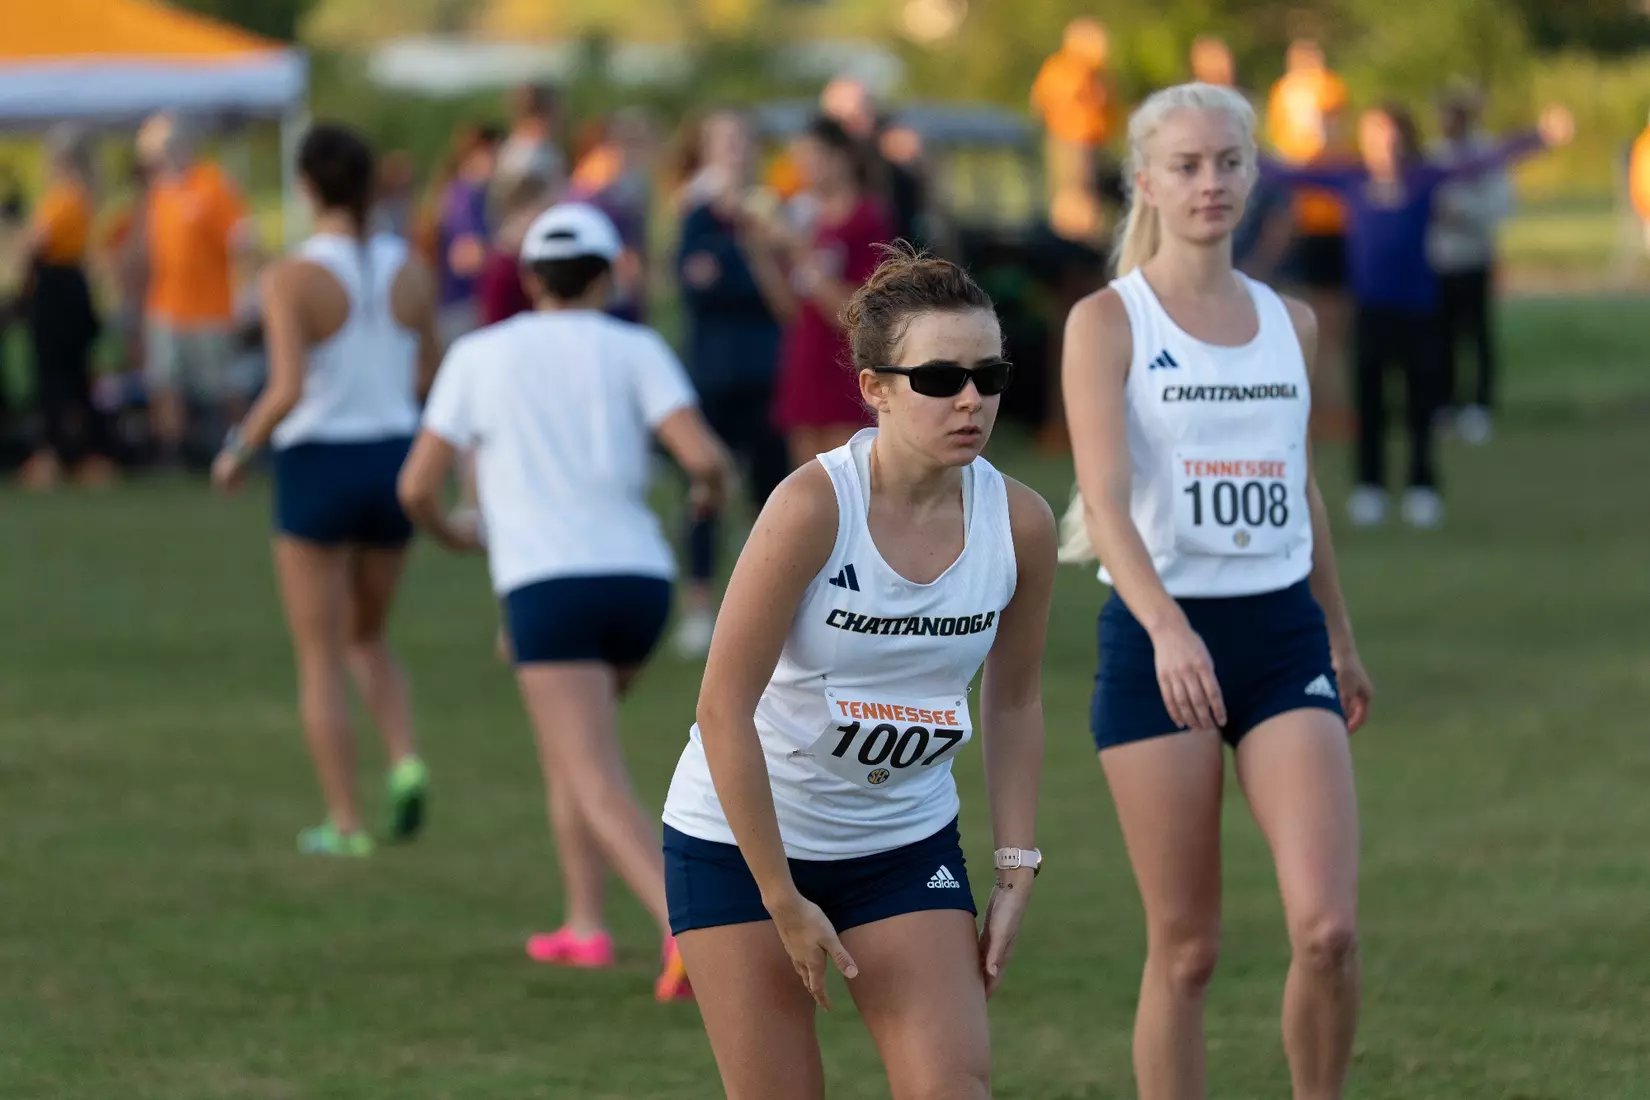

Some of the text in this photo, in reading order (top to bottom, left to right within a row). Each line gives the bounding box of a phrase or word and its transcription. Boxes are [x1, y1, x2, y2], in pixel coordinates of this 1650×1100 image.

[1183, 459, 1285, 478] TENNESSEE
[1184, 480, 1288, 527] 1008
[825, 608, 996, 636] CHATTANOOGA
[836, 700, 957, 726] TENNESSEE
[831, 720, 965, 768] 1007
[926, 879, 960, 889] adidas
